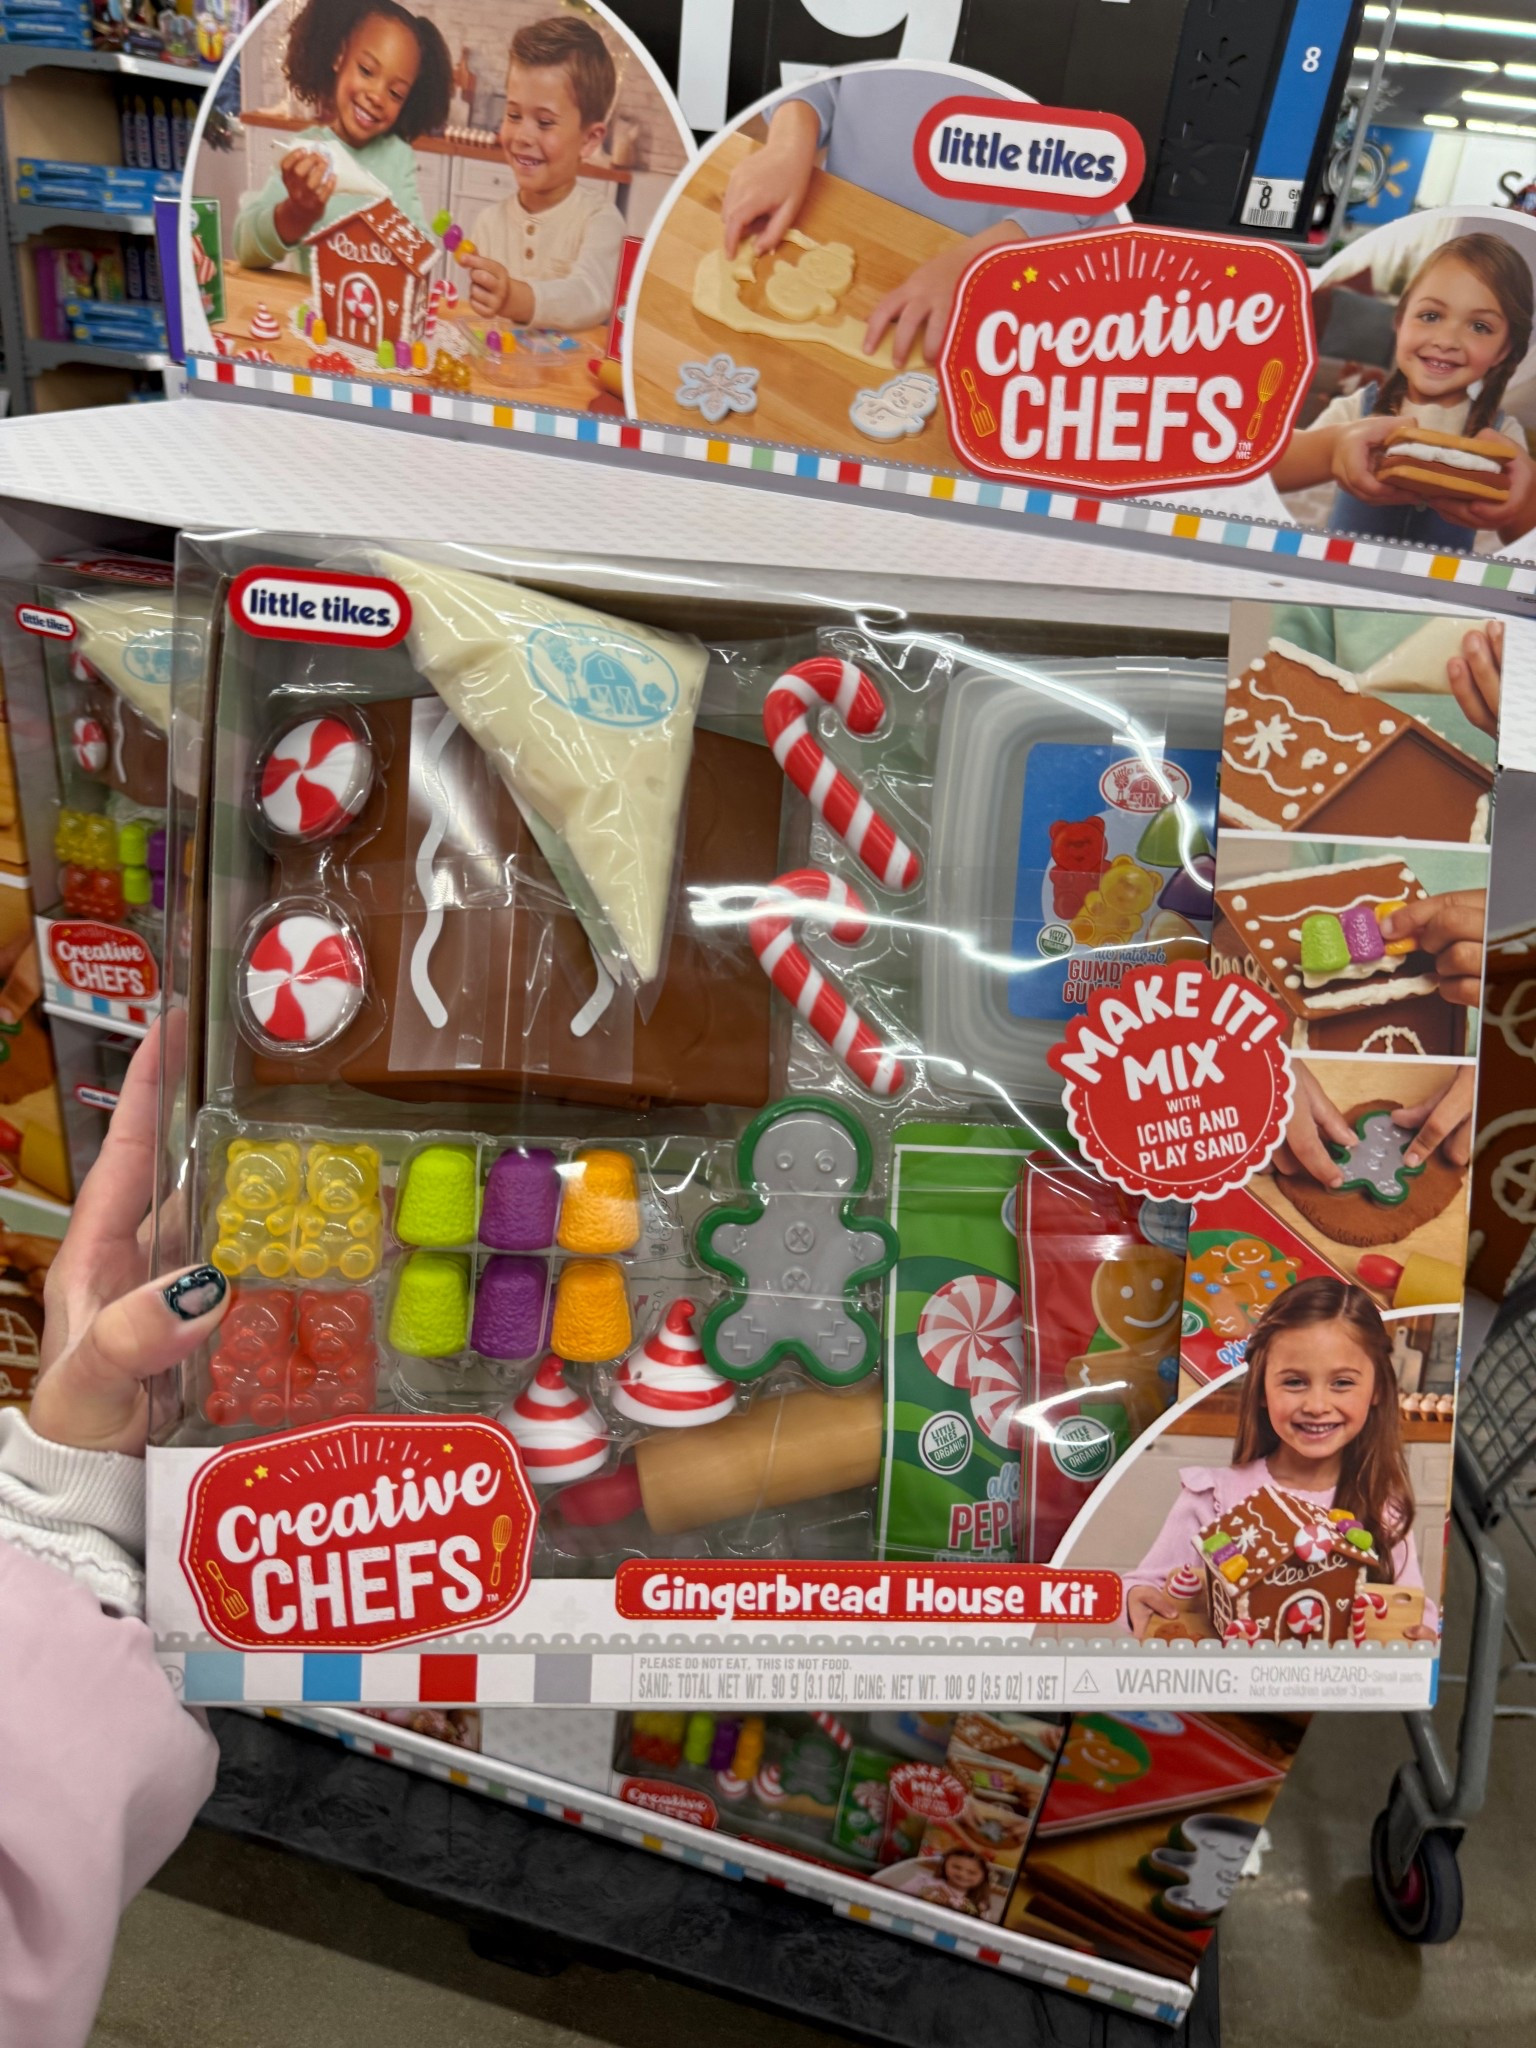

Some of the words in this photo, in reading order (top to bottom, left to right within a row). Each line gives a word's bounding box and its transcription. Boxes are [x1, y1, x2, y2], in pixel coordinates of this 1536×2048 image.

[1302, 46, 1322, 73] 8
[939, 126, 1022, 171] little
[1028, 137, 1116, 182] tikes
[1259, 185, 1273, 209] 8
[975, 289, 1285, 376] Creative
[1000, 375, 1243, 463] CHEFS
[250, 588, 316, 620] little
[322, 596, 391, 627] tikes
[57, 940, 145, 962] Creative
[71, 961, 145, 995] CHEFS
[1060, 971, 1203, 1085] MAKE
[1211, 983, 1278, 1051] IT!
[1122, 1038, 1225, 1101] MIX
[1166, 1095, 1202, 1113] WITH
[1137, 1116, 1193, 1147] ICING
[1199, 1106, 1240, 1129] AND
[1138, 1143, 1188, 1173] PLAY
[1193, 1132, 1248, 1162] SAND
[931, 1421, 955, 1440] LITTLE
[934, 1431, 958, 1447] TIKES
[934, 1438, 965, 1461] ORGANIC
[217, 1461, 501, 1563] Creative
[251, 1535, 484, 1635] CHEFS
[642, 1573, 890, 1621] Gingerbread
[906, 1577, 1024, 1615] House
[1040, 1581, 1098, 1616] Kit
[639, 1657, 682, 1670] PLEASE
[685, 1658, 699, 1670] DO
[702, 1658, 723, 1670] NOT
[726, 1658, 751, 1671] EAT.
[757, 1659, 781, 1671] THIS
[784, 1659, 795, 1671] IS
[798, 1659, 819, 1671] NOT
[1116, 1668, 1238, 1694] WARNING:
[1250, 1666, 1310, 1683] CHOKING
[639, 1672, 672, 1699] SAND:
[678, 1673, 712, 1699] TOTAL
[718, 1674, 741, 1699] NET
[746, 1674, 767, 1700] WT.
[771, 1674, 786, 1700] 90
[853, 1674, 886, 1700] ICING:
[891, 1674, 913, 1700] NET
[919, 1675, 939, 1700] WT.
[944, 1675, 962, 1701] 100
[1027, 1676, 1033, 1701] 1
[1037, 1676, 1059, 1701] SET
